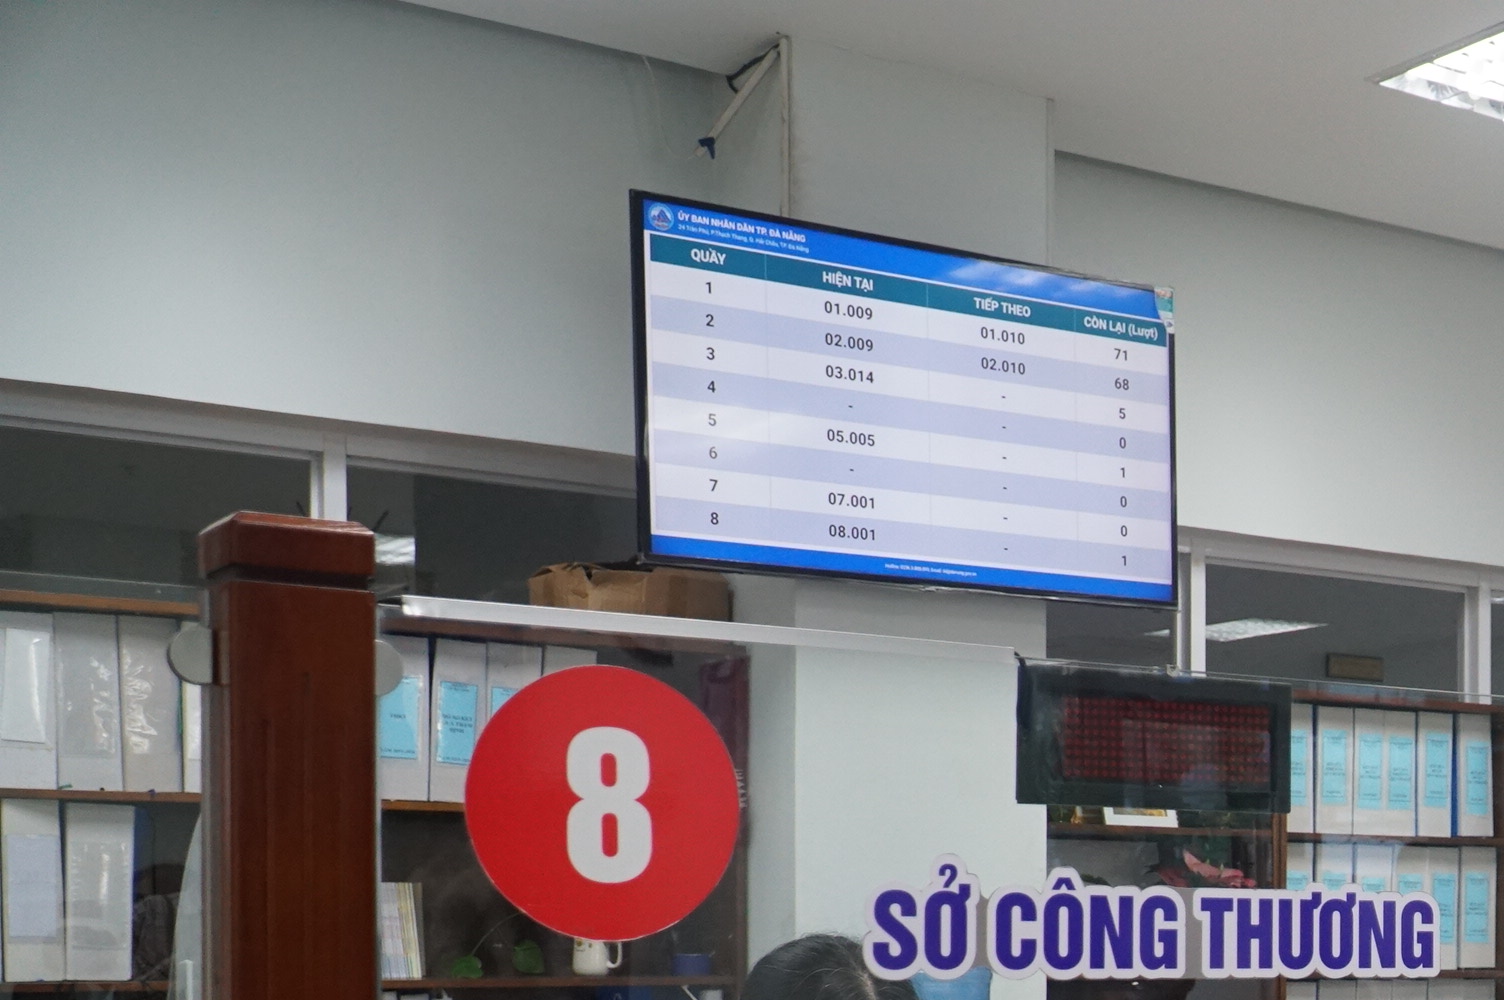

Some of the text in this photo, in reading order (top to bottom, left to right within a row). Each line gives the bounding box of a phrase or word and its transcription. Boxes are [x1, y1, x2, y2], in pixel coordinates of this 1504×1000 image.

[678, 210, 690, 221] ỦY
[691, 213, 709, 225] BAN
[711, 216, 735, 230] NHÂN
[737, 221, 755, 233] DÂN
[756, 226, 767, 235] TP.
[769, 227, 781, 238] ĐÀ
[691, 248, 726, 265] QUẦY
[823, 270, 873, 292] HIỆN TẠI
[705, 282, 712, 294] 1
[824, 302, 873, 320] 01.009
[974, 297, 1031, 316] TIẾP THEO
[705, 314, 714, 326] 2
[1084, 314, 1158, 340] CÒN LẠI (Lượt)
[980, 327, 1025, 345] 01.010
[825, 334, 873, 352] 02.009
[706, 348, 715, 360] 3
[1114, 349, 1128, 361] 71
[981, 357, 1026, 375] 02.010
[825, 366, 874, 383] 03.014
[707, 381, 716, 393] 4
[1115, 379, 1129, 391] 68
[708, 414, 717, 426] 5
[1119, 408, 1126, 420] 5
[827, 429, 875, 447] 05.005
[1119, 437, 1127, 449] 0
[709, 447, 718, 459] 6
[1120, 467, 1126, 478] 1
[709, 480, 718, 492] 7
[828, 493, 876, 509] 07.001
[1120, 496, 1127, 507] 0
[710, 513, 719, 525] 8
[829, 525, 876, 541] 08.001
[1120, 526, 1128, 537] 0
[1121, 555, 1127, 566] 1
[566, 726, 652, 884] 8
[872, 863, 1435, 972] SỞ CÔNG THƯƠNG
